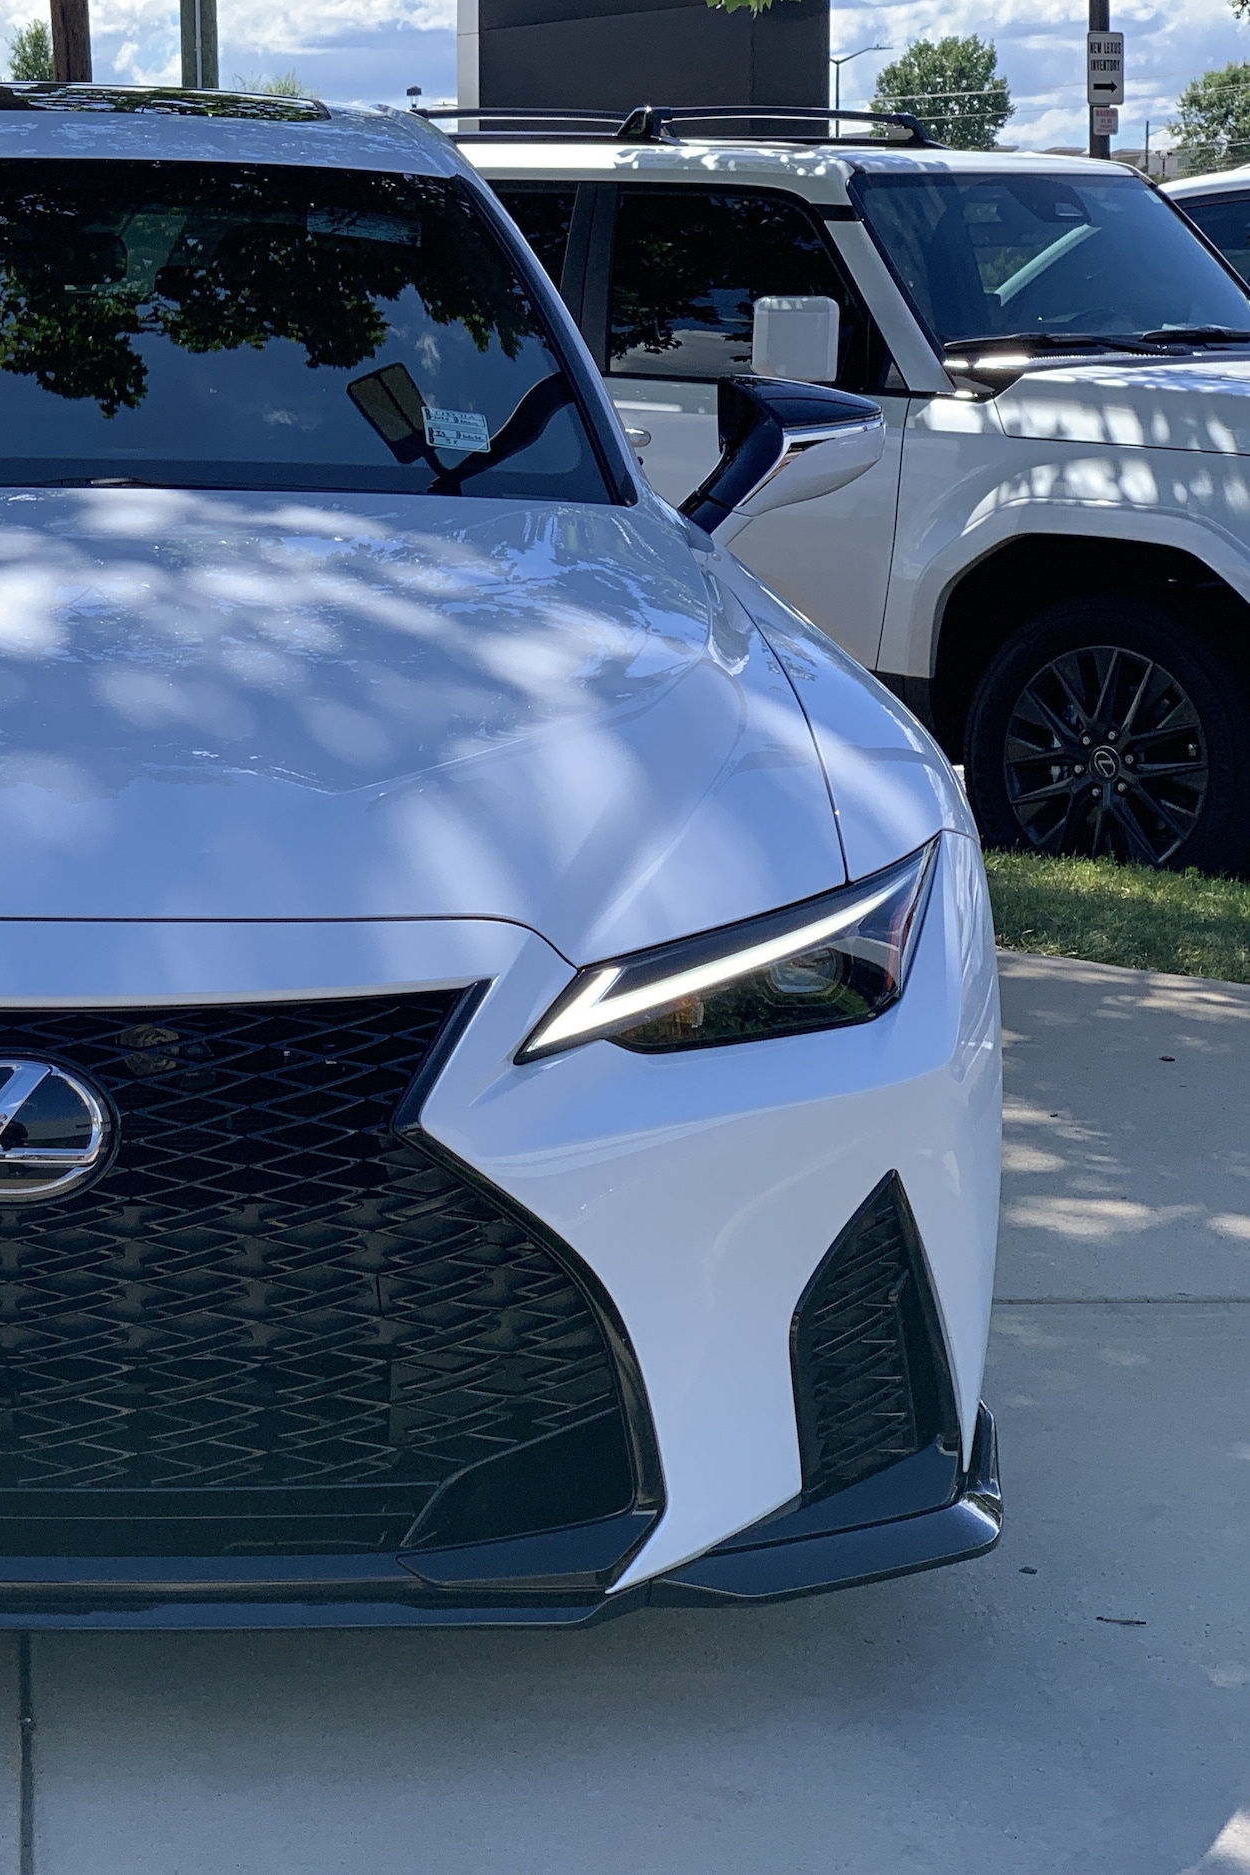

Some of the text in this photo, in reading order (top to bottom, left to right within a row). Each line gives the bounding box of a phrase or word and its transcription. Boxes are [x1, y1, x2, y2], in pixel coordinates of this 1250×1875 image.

[1090, 42, 1121, 54] NEW LEXUS
[1090, 60, 1120, 71] INVENTORY
